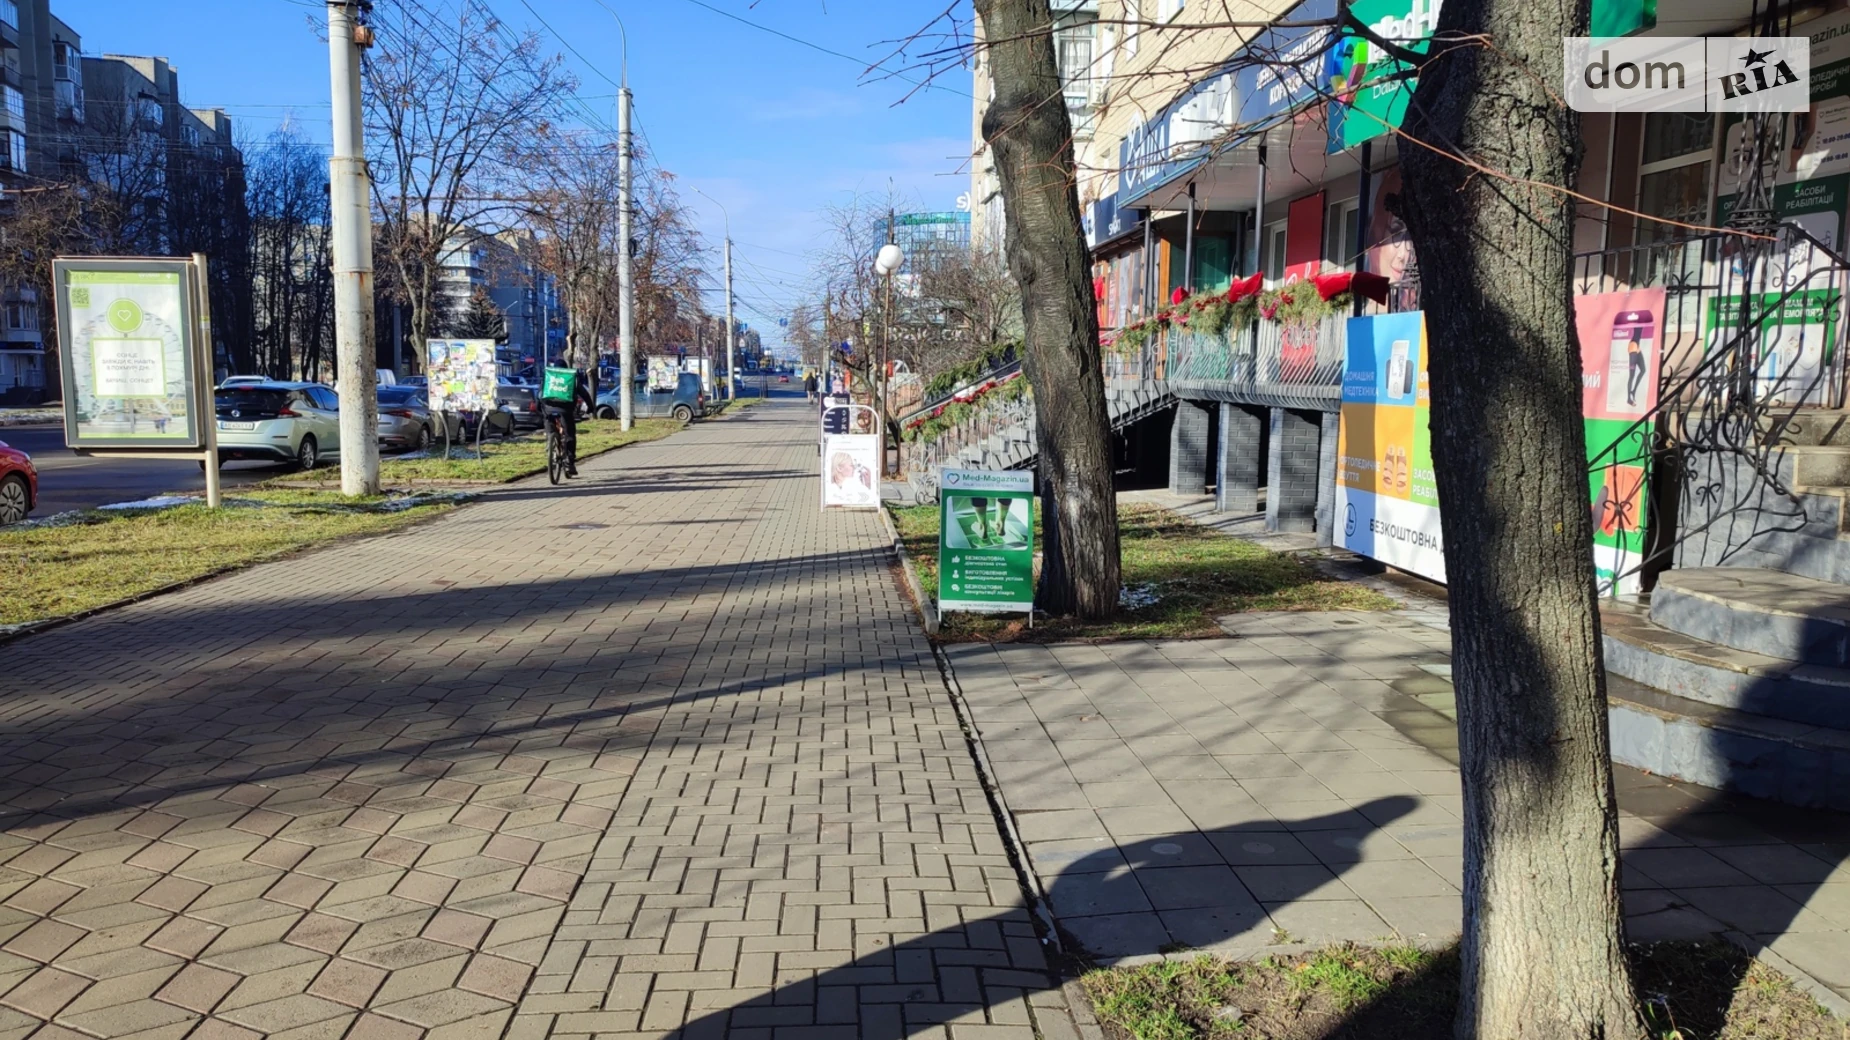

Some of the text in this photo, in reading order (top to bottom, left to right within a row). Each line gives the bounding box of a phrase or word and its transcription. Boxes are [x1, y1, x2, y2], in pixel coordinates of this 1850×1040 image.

[1795, 185, 1826, 198] ЗАСОБИ
[1786, 192, 1835, 210] РЕАБІЛІТАЦІЇ
[1344, 371, 1375, 382] ДОМАШНЯ
[1344, 385, 1379, 397] МЕДТЕХНІКА
[962, 474, 1030, 485] Med-Magazin.ua
[1369, 518, 1438, 552] БЕЗКОШТОВНА
